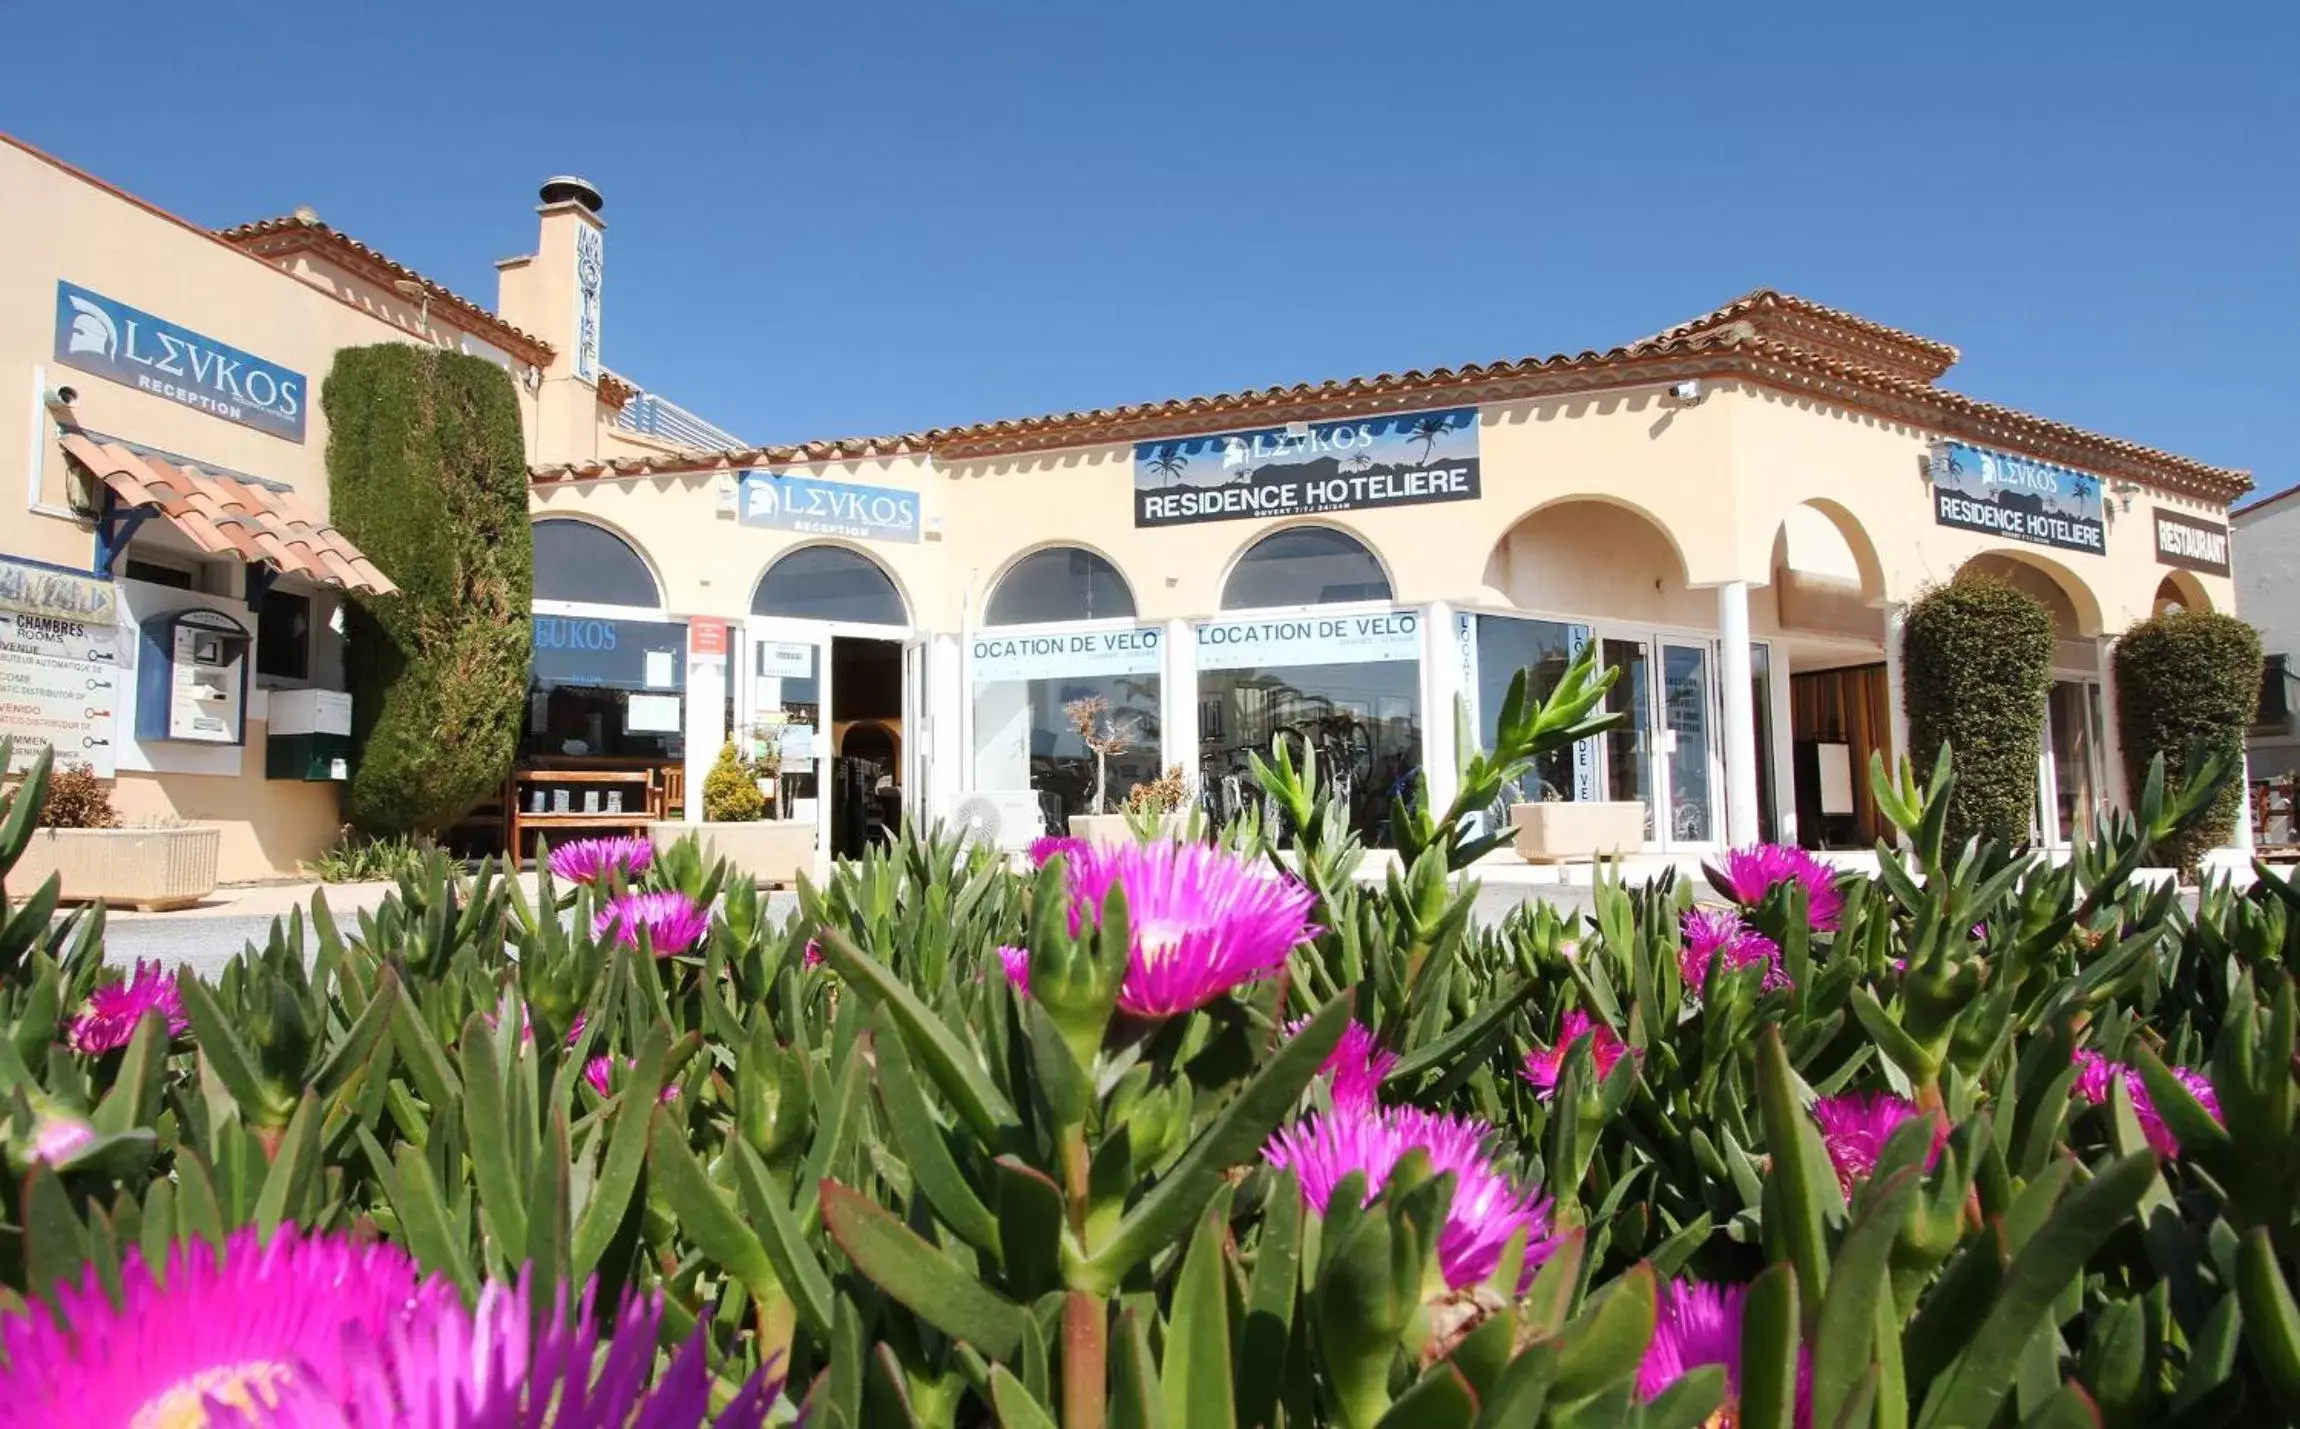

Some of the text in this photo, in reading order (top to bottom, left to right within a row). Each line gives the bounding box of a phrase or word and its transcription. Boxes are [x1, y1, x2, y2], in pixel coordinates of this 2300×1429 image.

[138, 374, 242, 419] RECEPTION
[1144, 468, 1469, 519] RESIDENCE HOTELIERE
[794, 520, 870, 537] RECEPTION
[1941, 496, 2101, 548] RESIDENCE HOTELIERE
[2158, 518, 2227, 565] RESTAURANT
[17, 614, 84, 637] CHAMBRES
[17, 629, 64, 643] ROOMS
[1199, 616, 1416, 645] LOCATION DE VELO
[974, 631, 1157, 659] OCATION DE VELO
